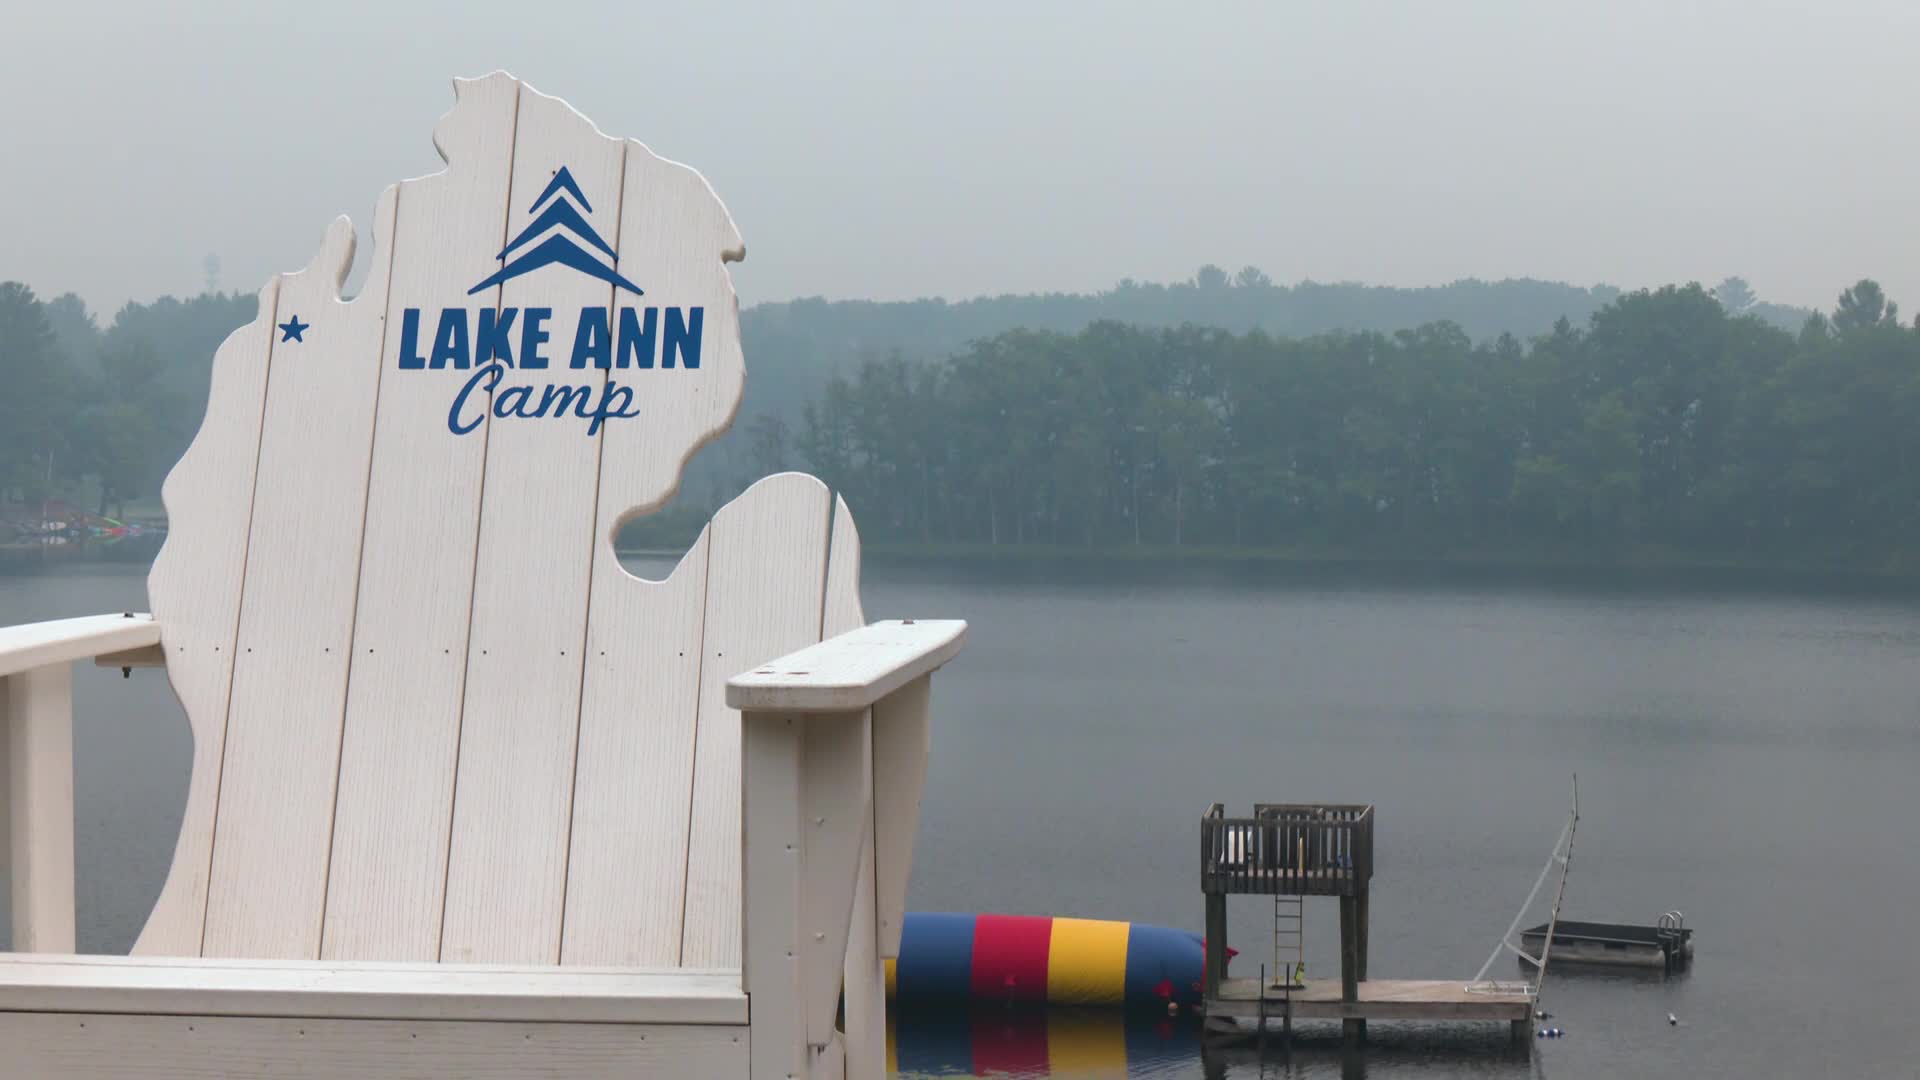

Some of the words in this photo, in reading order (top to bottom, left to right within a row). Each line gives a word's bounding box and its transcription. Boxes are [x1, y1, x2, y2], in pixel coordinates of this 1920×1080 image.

[398, 307, 553, 370] LAKE
[569, 306, 705, 369] ANN
[447, 363, 641, 437] Camp
